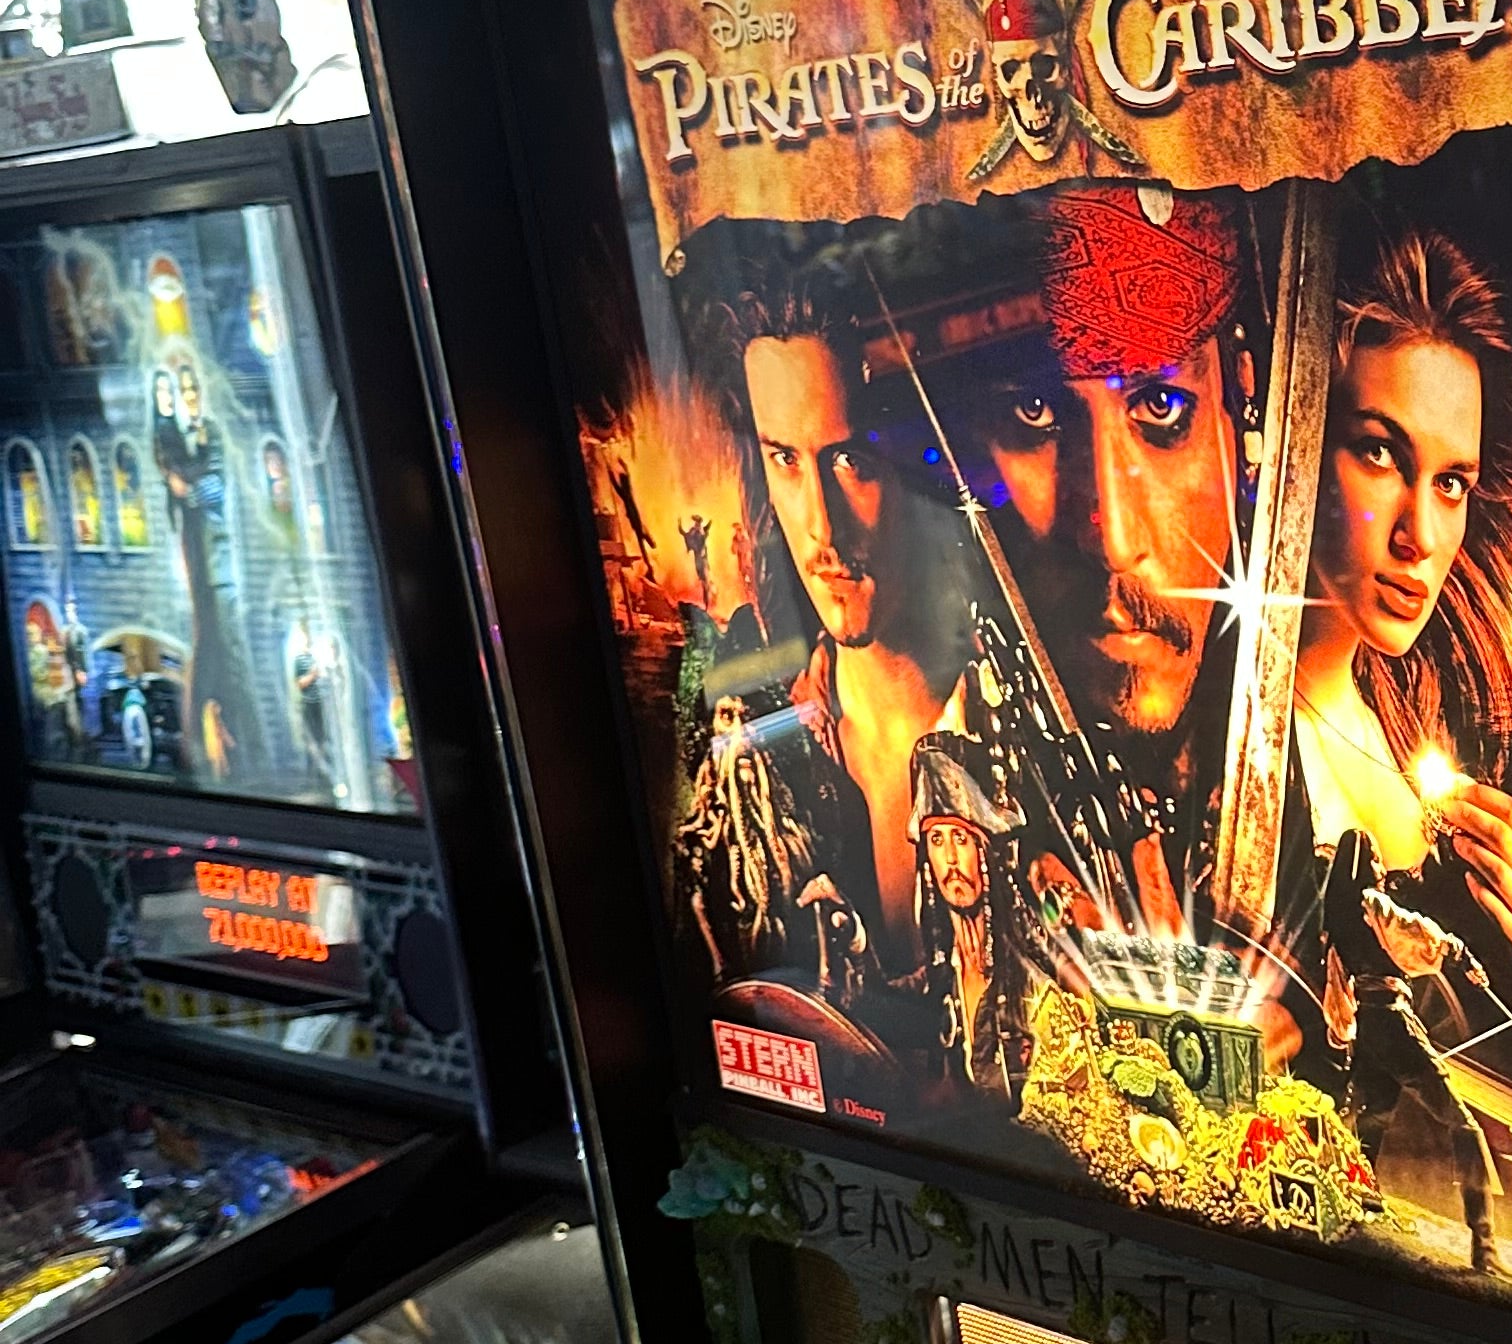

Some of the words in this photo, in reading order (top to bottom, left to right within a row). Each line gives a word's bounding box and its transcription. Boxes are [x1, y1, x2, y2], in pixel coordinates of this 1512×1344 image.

[948, 38, 979, 73] of
[634, 40, 936, 163] PIRATES
[934, 73, 984, 108] the
[718, 1026, 817, 1087] STERN
[844, 1098, 887, 1128] Disney
